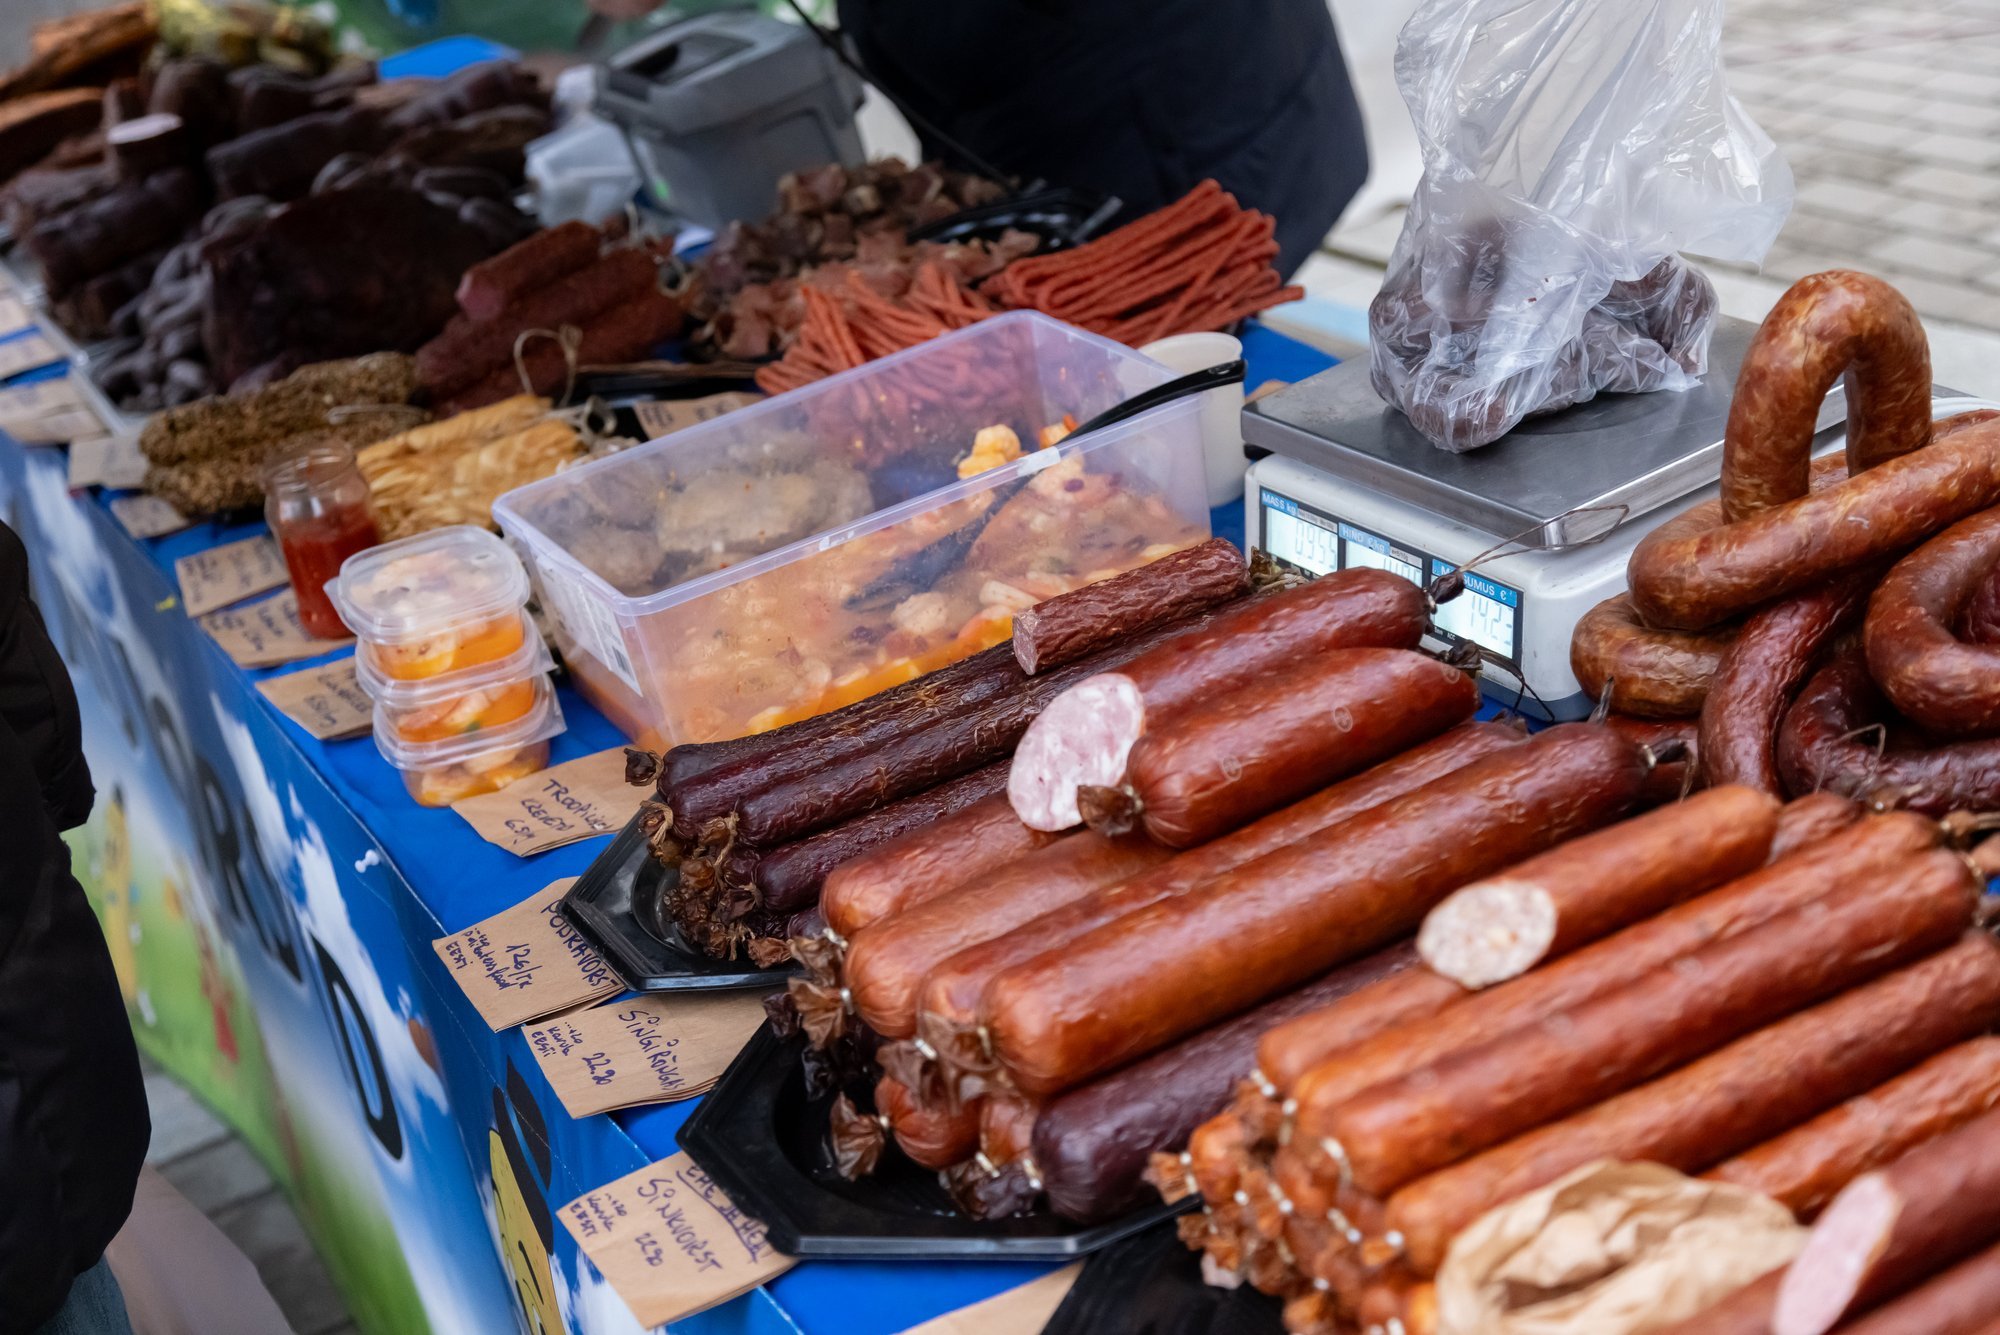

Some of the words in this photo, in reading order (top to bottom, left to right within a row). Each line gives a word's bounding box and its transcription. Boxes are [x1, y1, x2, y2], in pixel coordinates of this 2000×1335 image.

[1262, 492, 1285, 510] MASS
[1286, 503, 1297, 516] kg
[1342, 526, 1364, 542] HIND
[1441, 565, 1495, 596] MSUMUS
[1500, 590, 1507, 601] €
